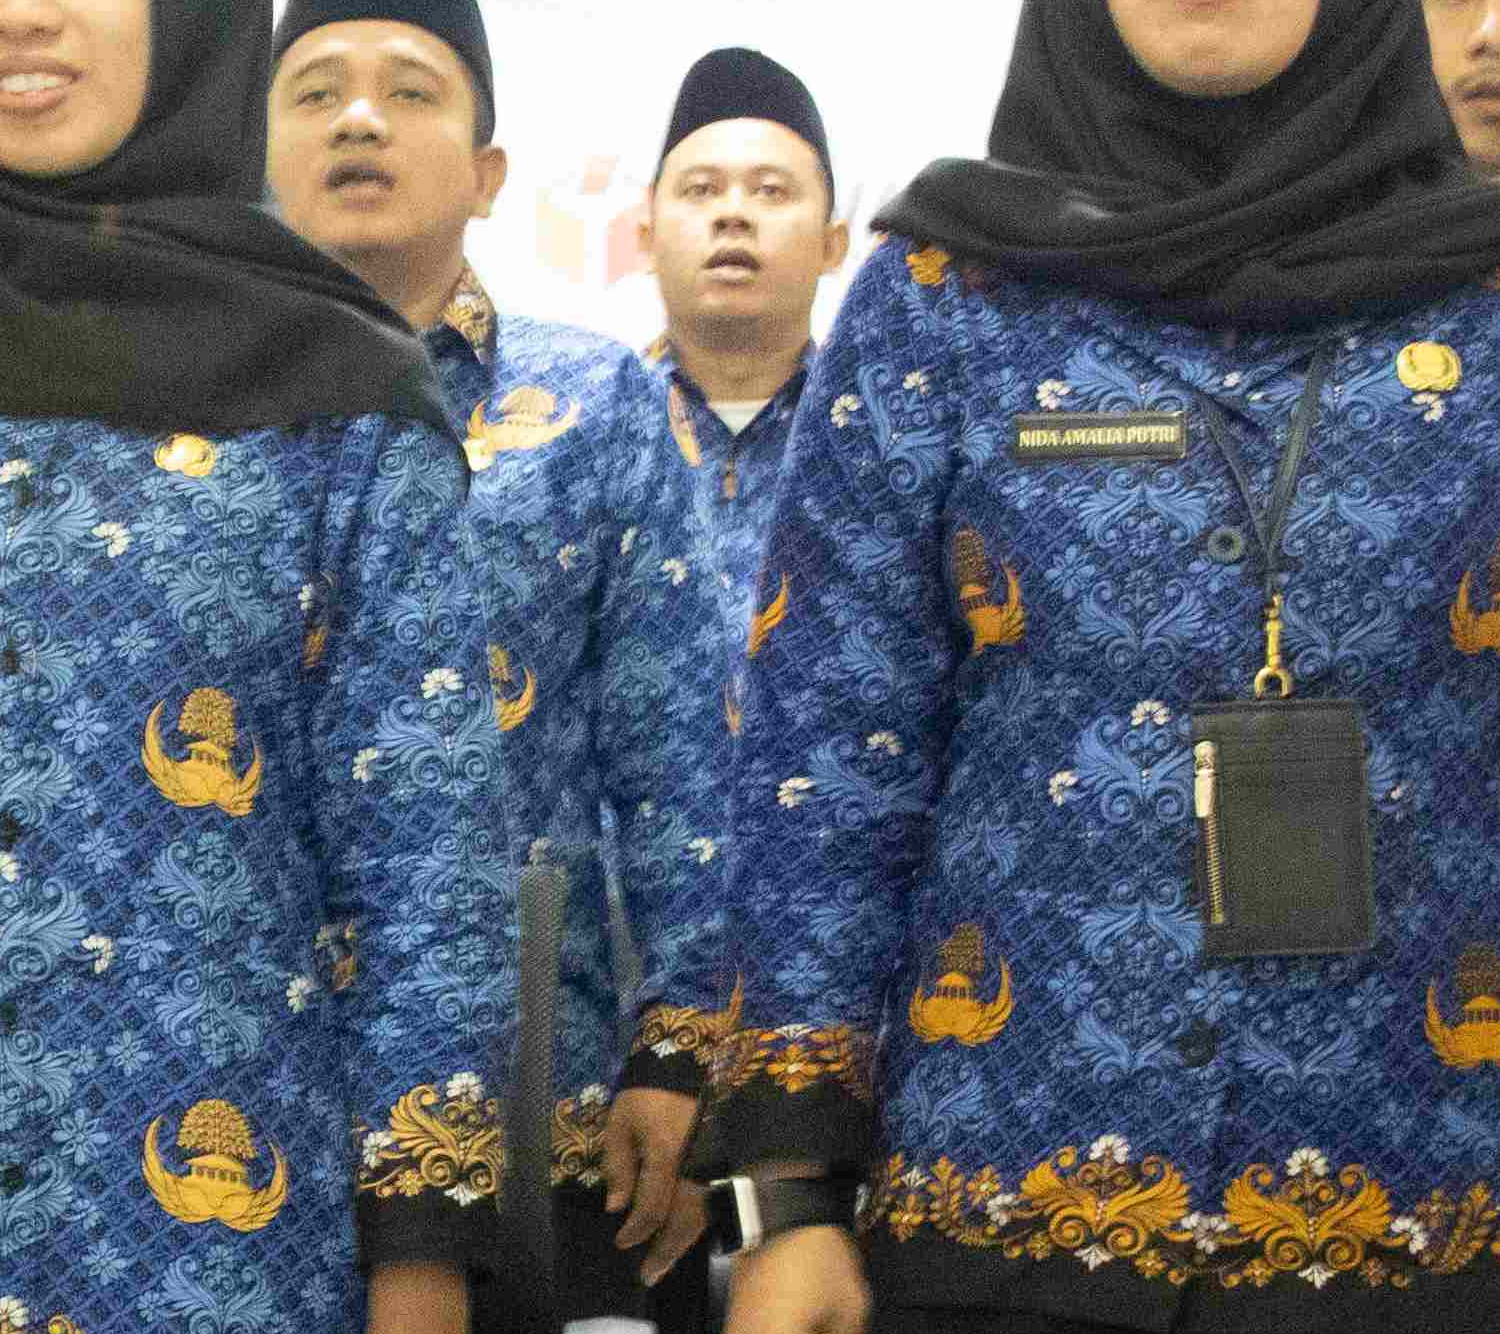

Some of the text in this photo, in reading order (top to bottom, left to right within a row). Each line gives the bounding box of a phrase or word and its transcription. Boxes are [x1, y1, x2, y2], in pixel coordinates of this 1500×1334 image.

[1018, 425, 1178, 447] NIDA AMALIA PUTRI
